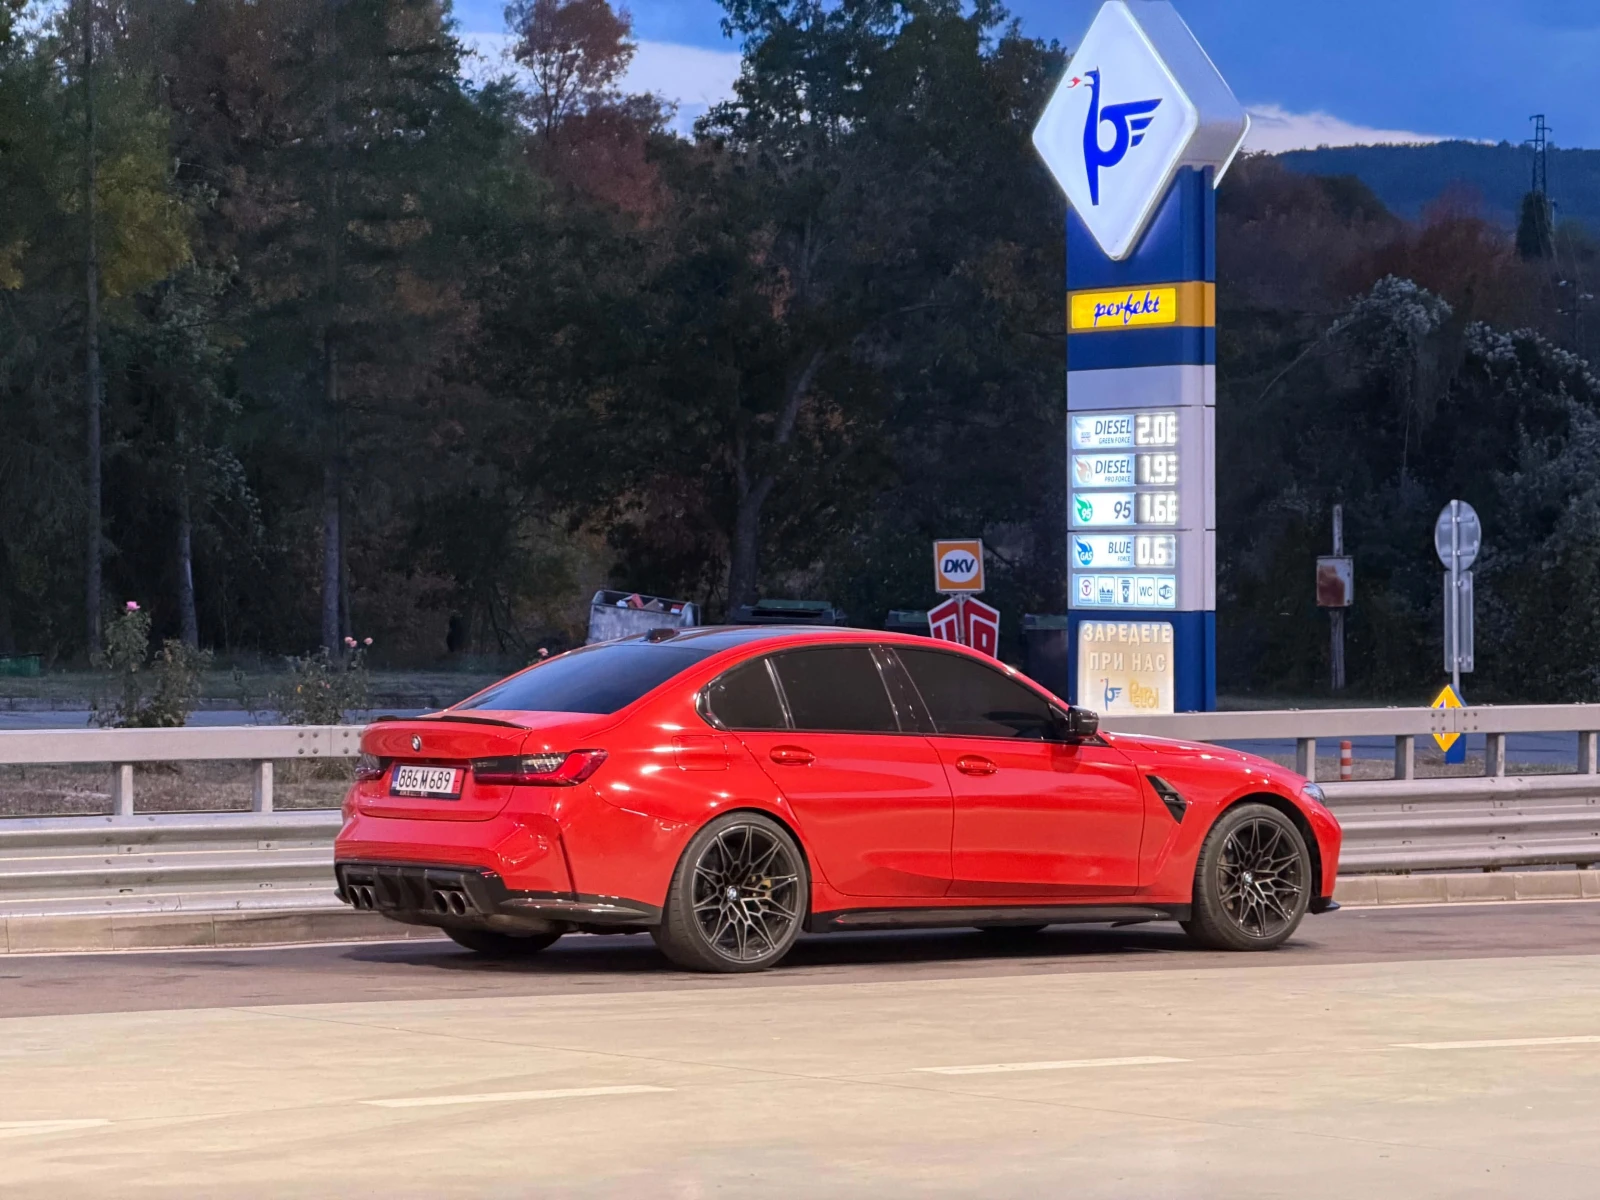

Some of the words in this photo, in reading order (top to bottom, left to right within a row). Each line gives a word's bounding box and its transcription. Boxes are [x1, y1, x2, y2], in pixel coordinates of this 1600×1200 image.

[1094, 290, 1160, 327] perfekt
[1095, 419, 1132, 435] DIESEL
[1095, 459, 1132, 475] DIESEL
[1113, 501, 1131, 519] 95
[1108, 541, 1132, 554] BLUE
[943, 558, 975, 573] DKV
[1139, 586, 1153, 597] WC
[1083, 623, 1171, 646] ЗАРЕДЕТЕ
[1089, 652, 1124, 671] ПРИ
[1132, 652, 1166, 672] НАС
